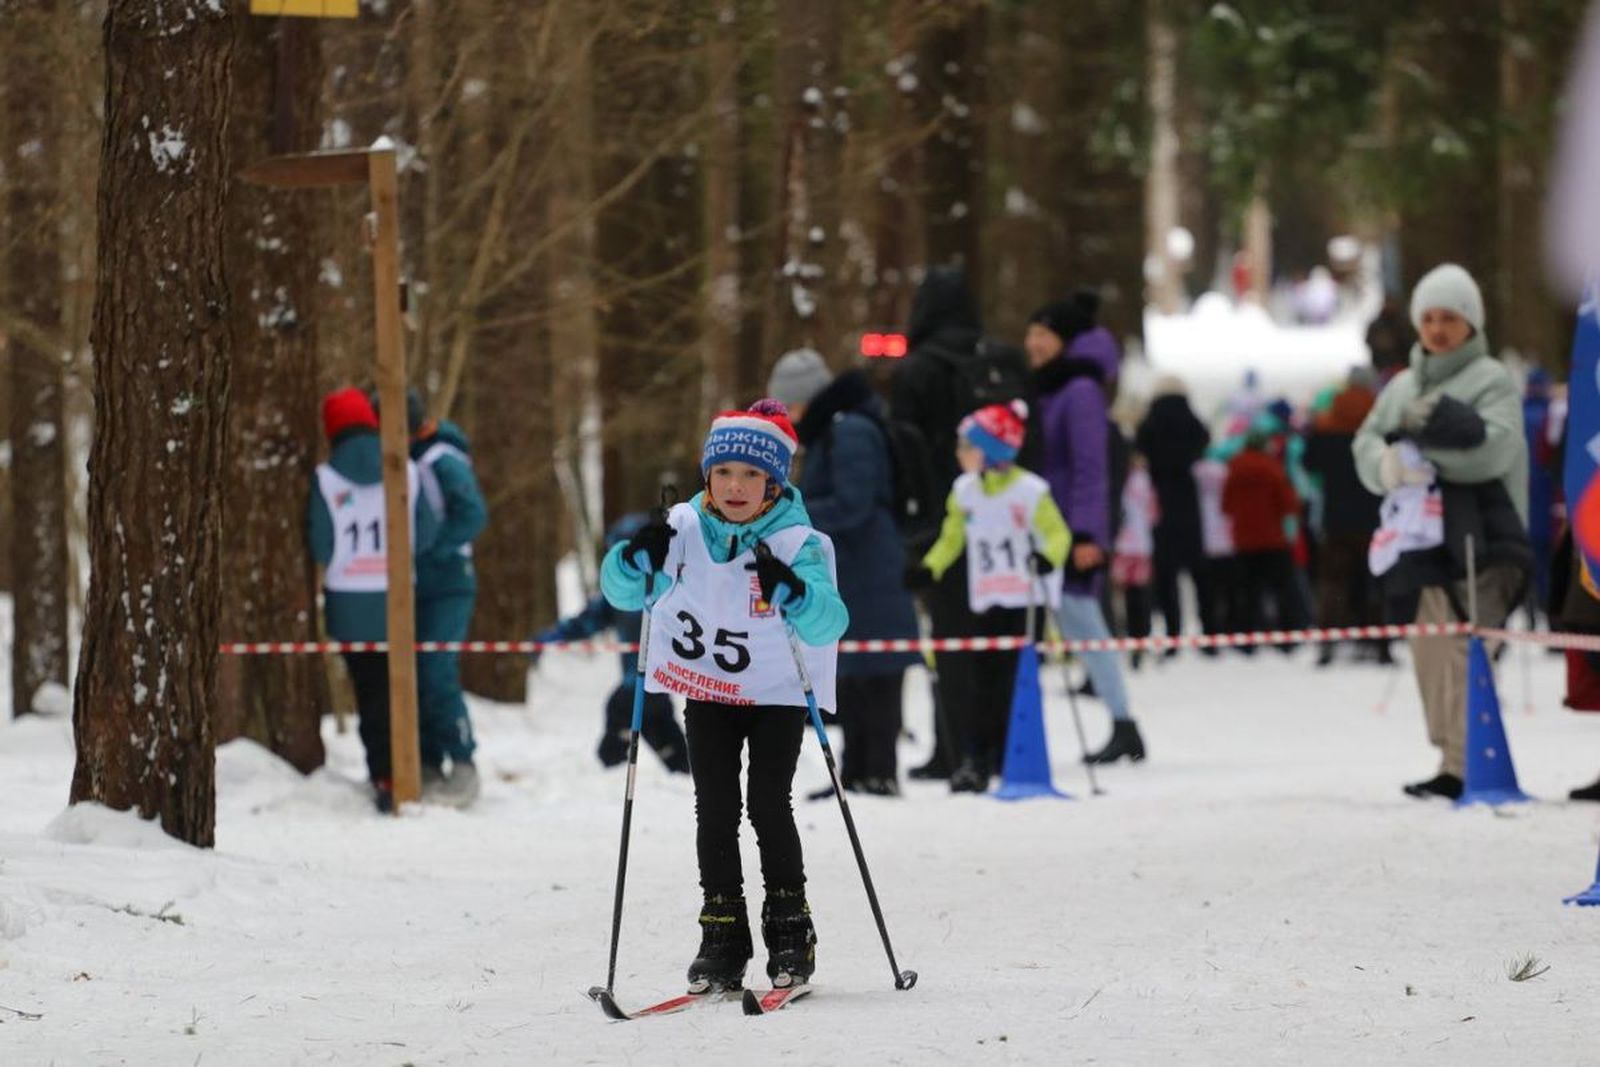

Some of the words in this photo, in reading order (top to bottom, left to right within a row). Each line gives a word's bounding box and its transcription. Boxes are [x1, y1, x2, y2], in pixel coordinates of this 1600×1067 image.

[345, 518, 381, 552] 11
[672, 610, 751, 674] 35
[667, 661, 741, 696] ПОСЕЛЕНИЕ
